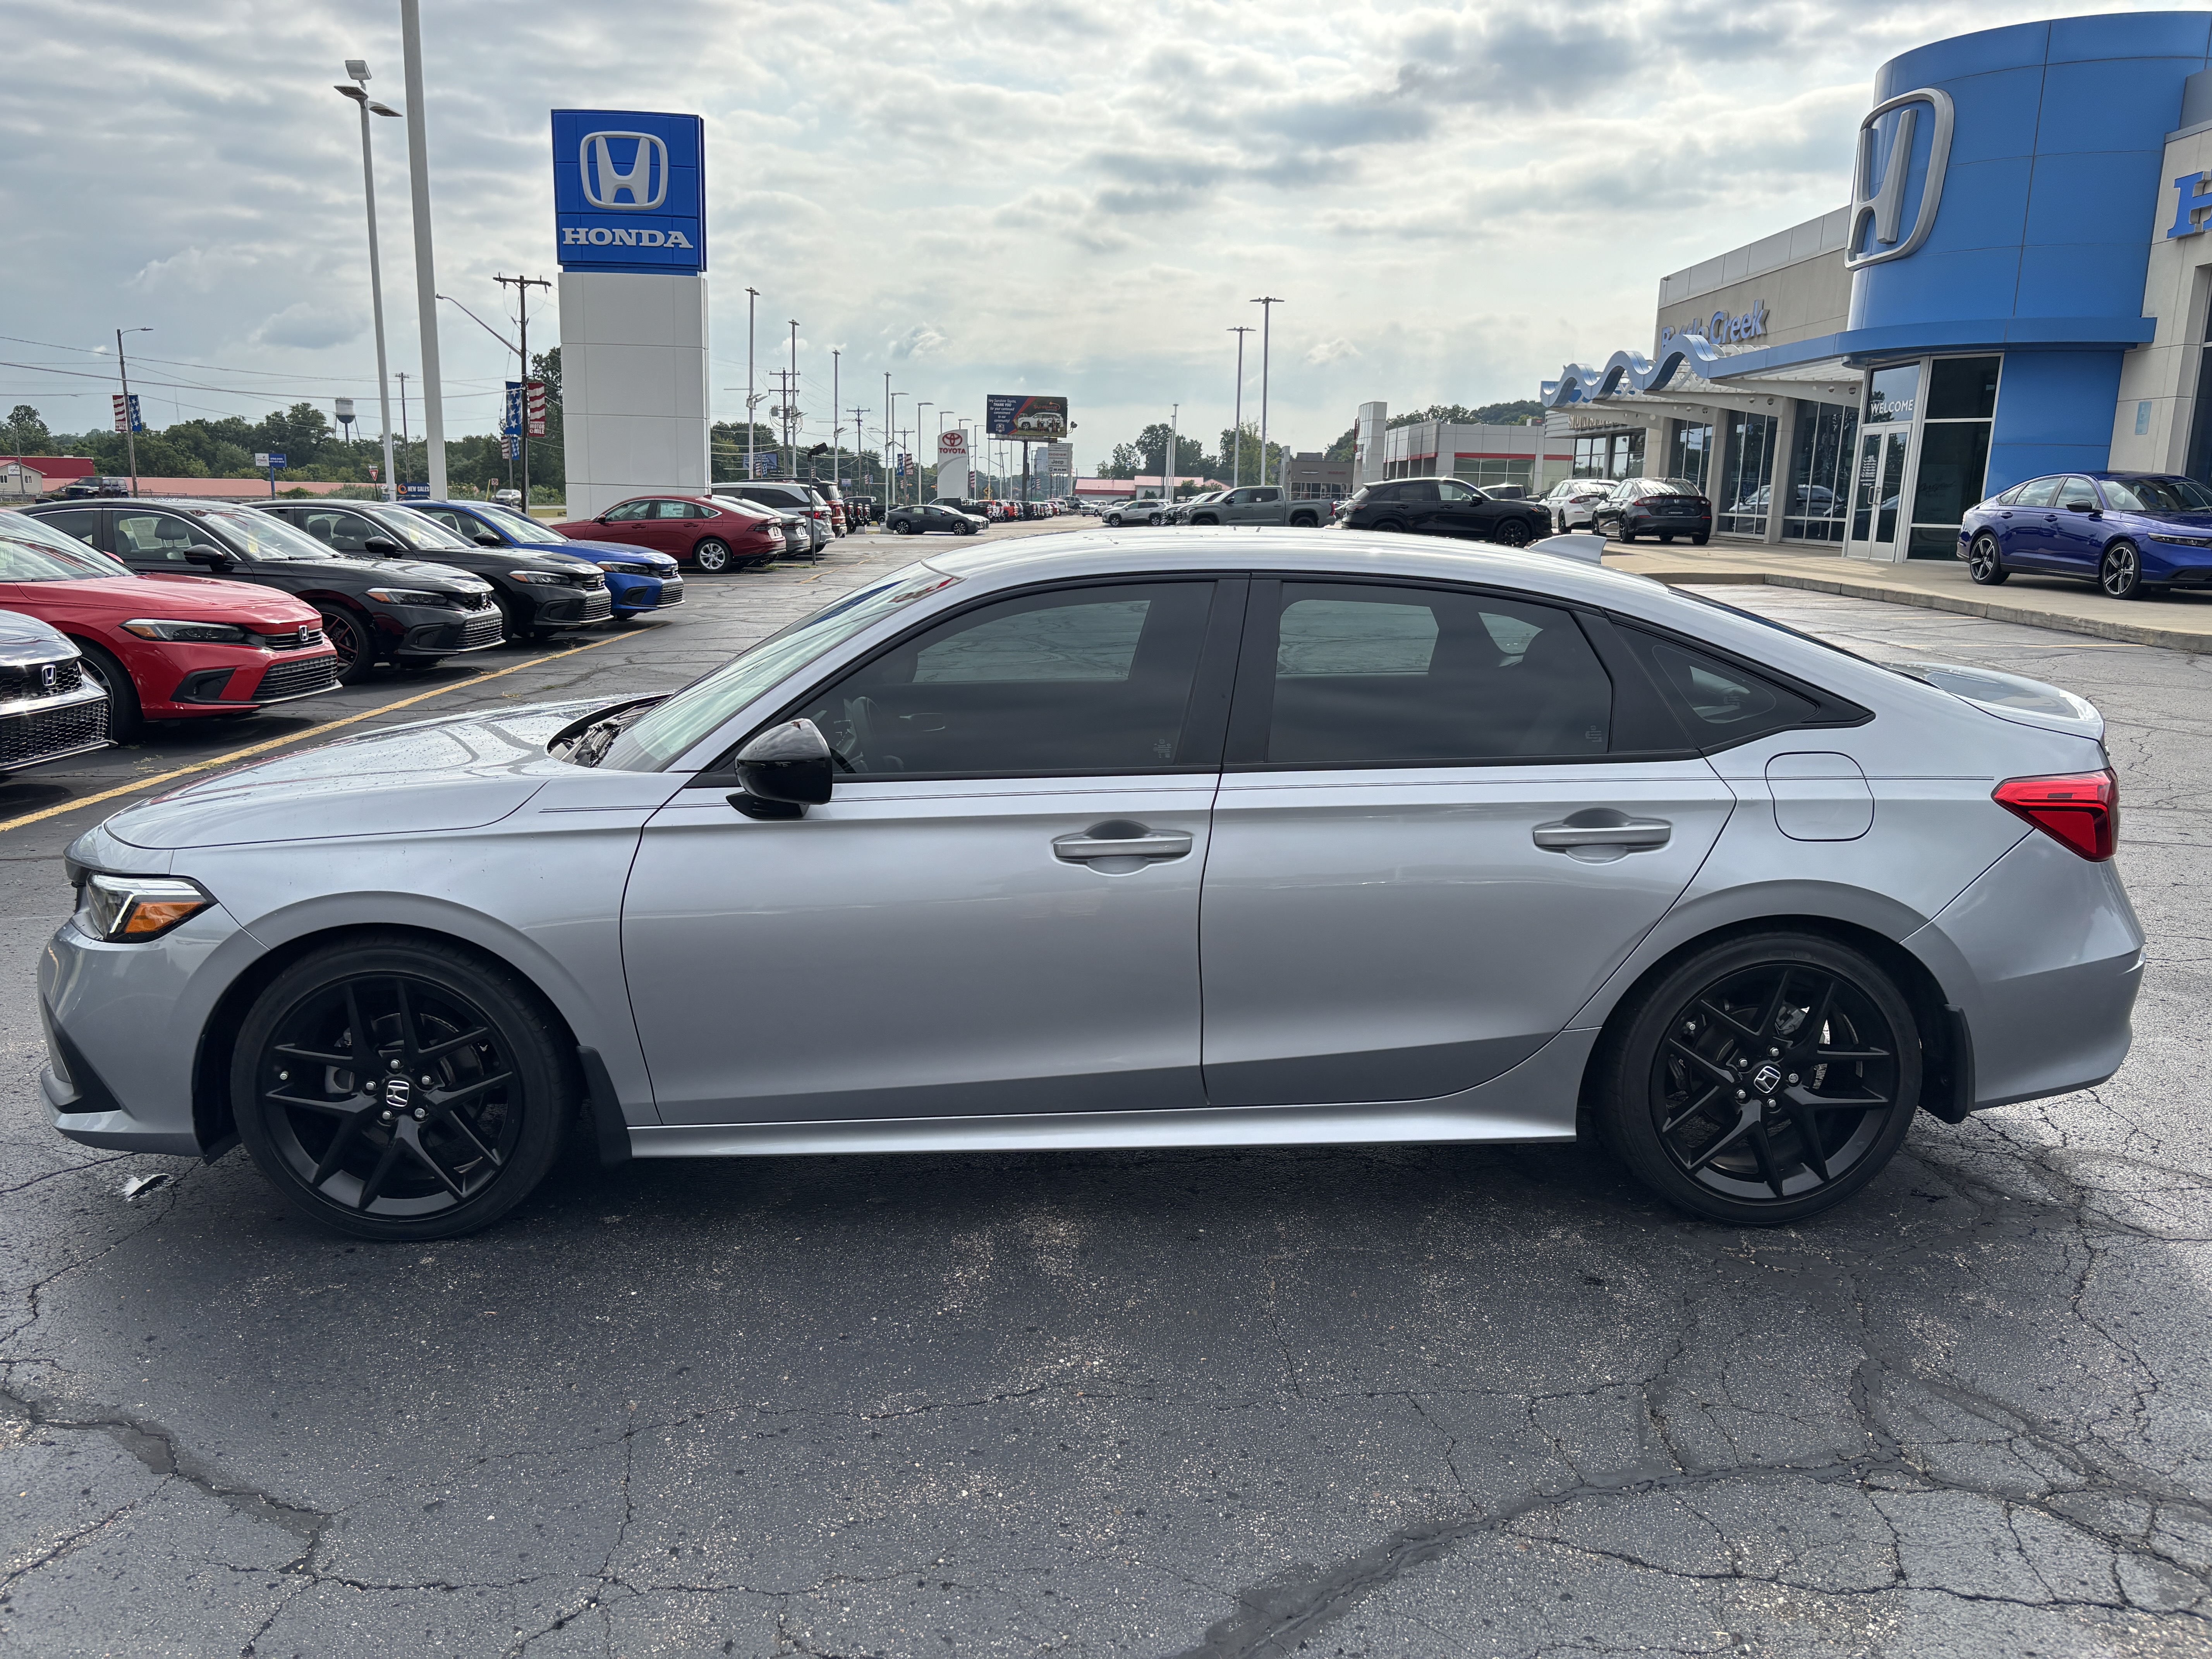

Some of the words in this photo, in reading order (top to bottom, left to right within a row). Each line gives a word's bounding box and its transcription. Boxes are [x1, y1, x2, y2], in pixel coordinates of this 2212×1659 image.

[562, 228, 694, 249] HONDA
[1709, 299, 1770, 345] Creek
[1871, 399, 1914, 414] WELCOME
